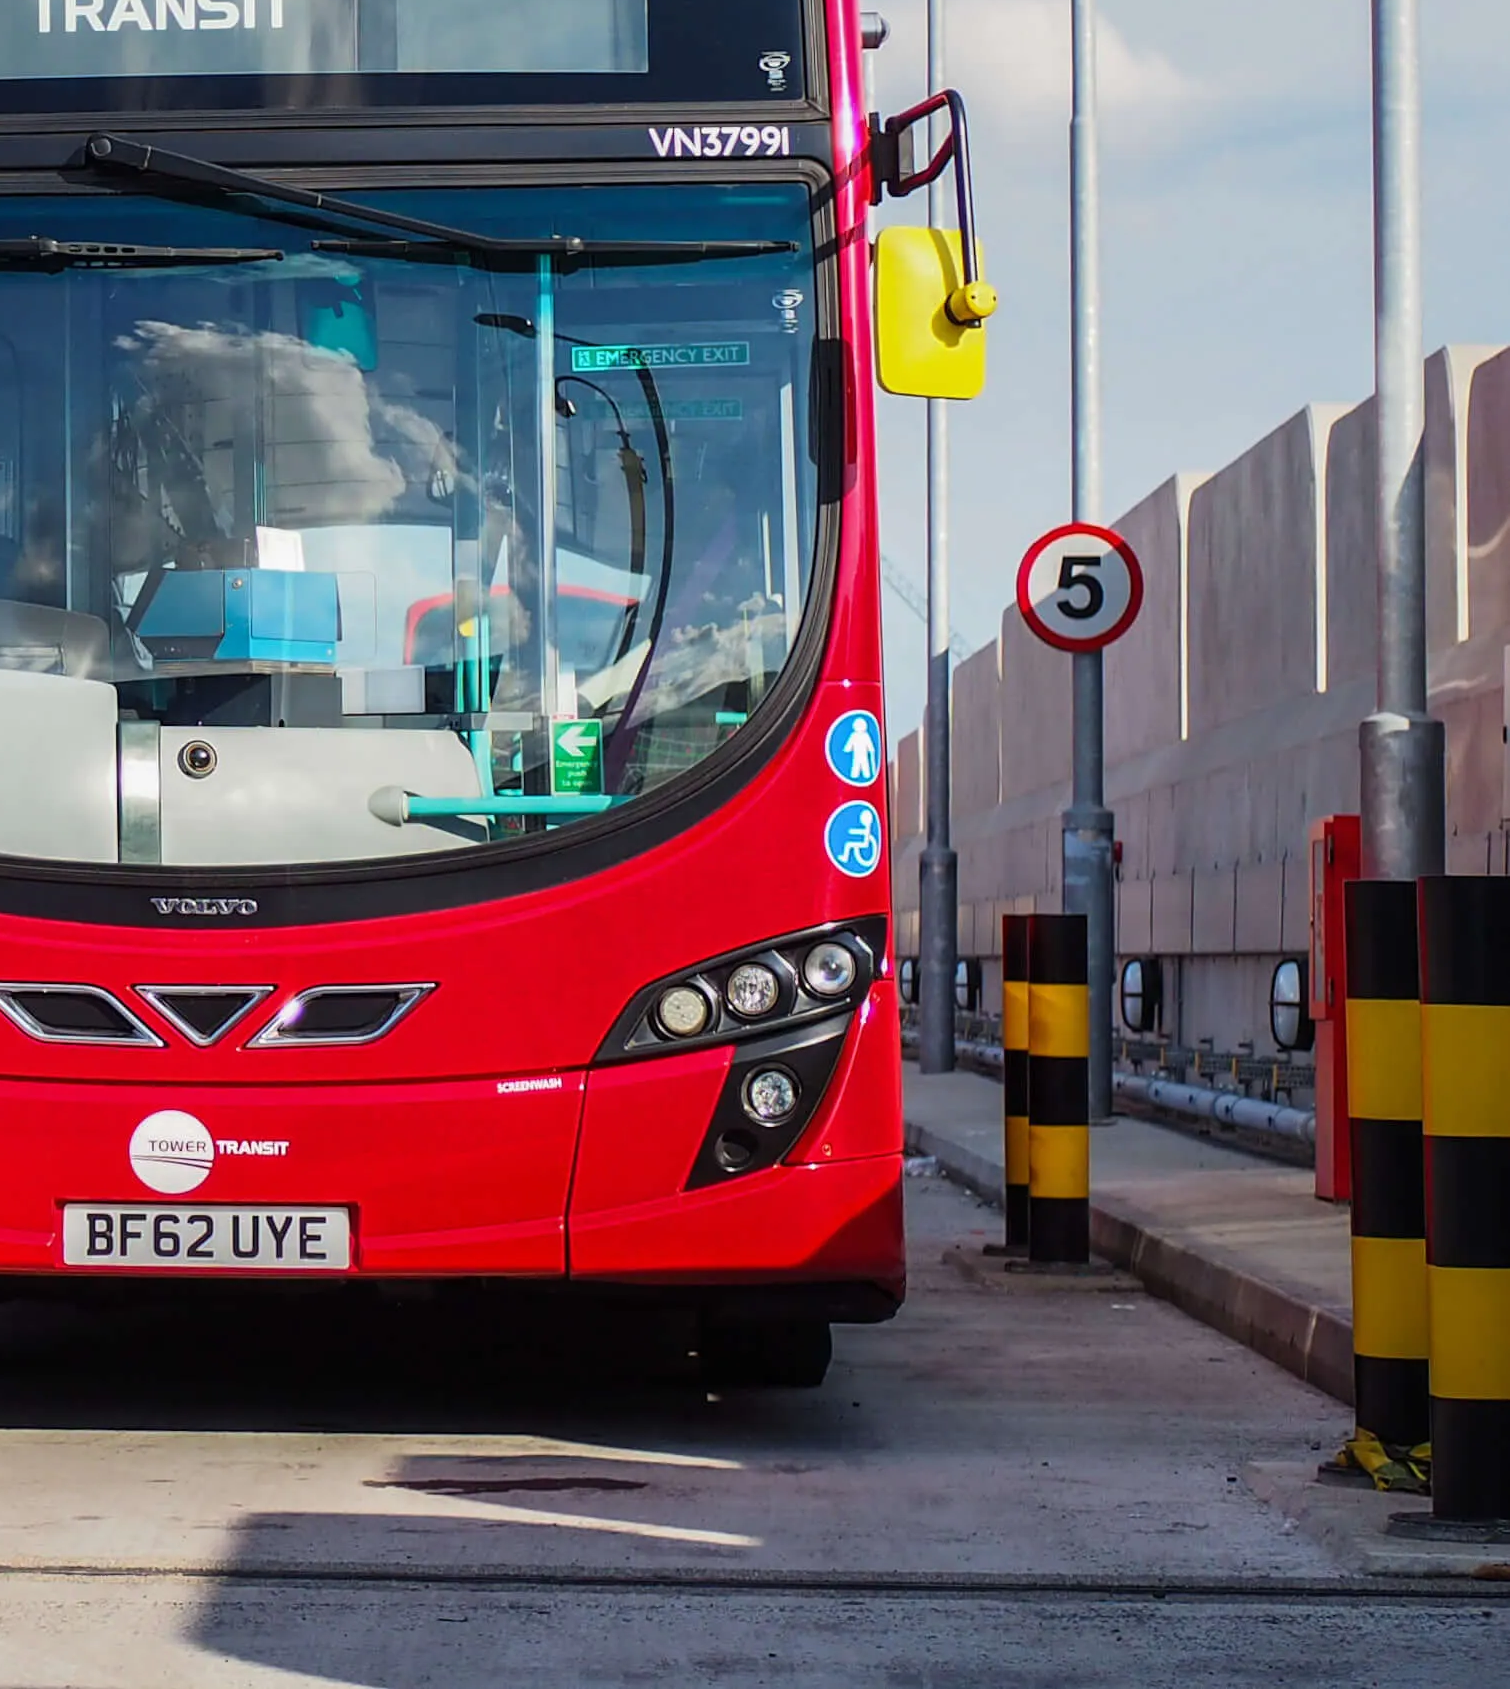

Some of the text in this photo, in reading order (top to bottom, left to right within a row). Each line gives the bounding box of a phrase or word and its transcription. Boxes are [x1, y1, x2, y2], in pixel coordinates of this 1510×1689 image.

[648, 126, 790, 157] VN37991
[596, 346, 740, 366] EMERGENCY EXIT
[1057, 556, 1104, 619] 5
[555, 761, 598, 769] Emergeny
[150, 898, 258, 915] VOLVO
[148, 1139, 289, 1156] TOWER TRANSIT
[86, 1213, 327, 1260] BF62 UYE
